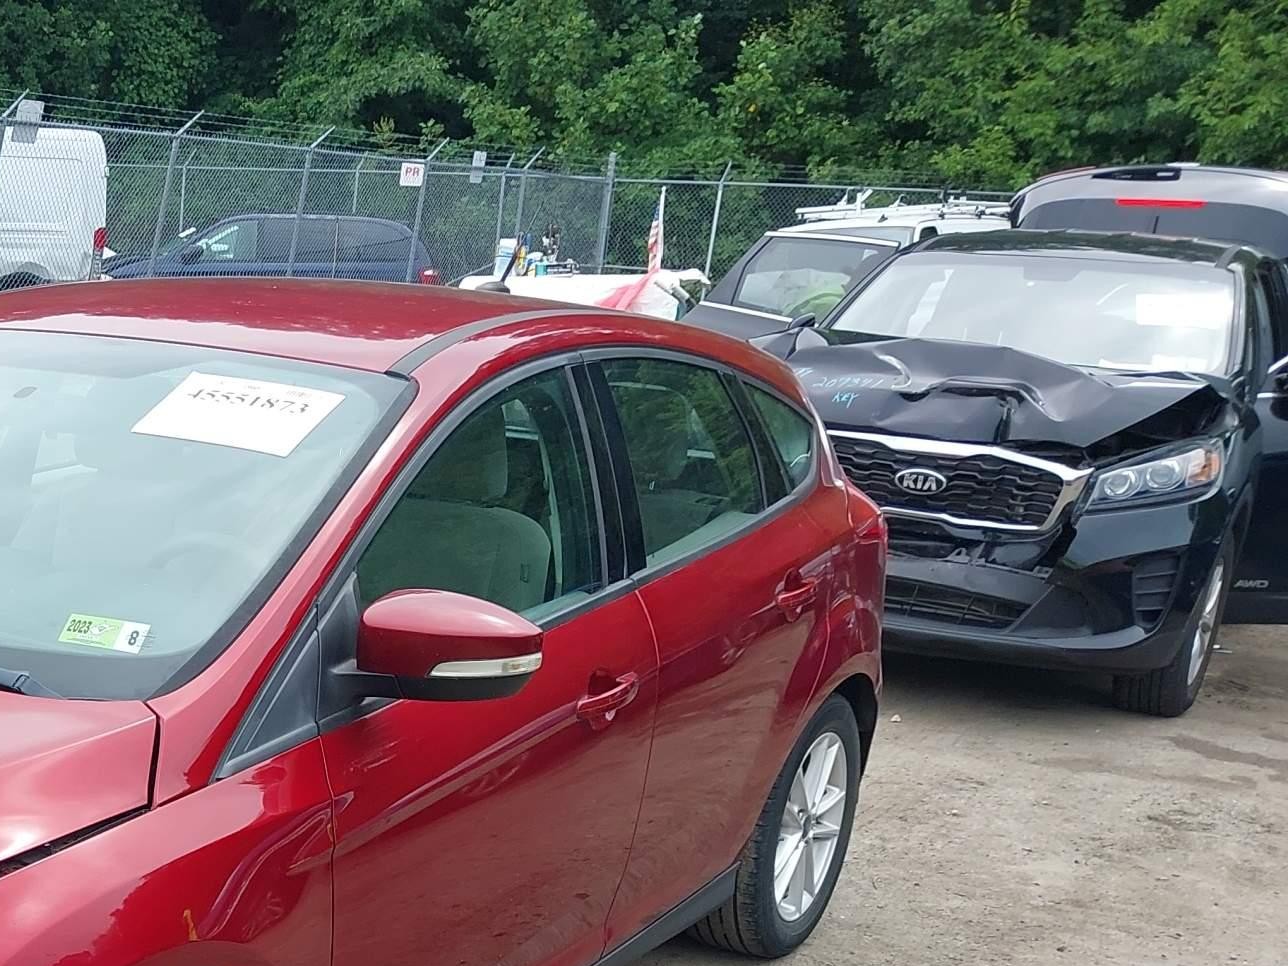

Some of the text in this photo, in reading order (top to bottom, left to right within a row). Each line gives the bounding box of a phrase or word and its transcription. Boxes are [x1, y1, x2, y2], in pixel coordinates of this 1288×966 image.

[902, 473, 937, 490] KIA
[1233, 579, 1270, 588] AWD
[66, 619, 93, 634] 2023
[128, 630, 140, 646] 8
